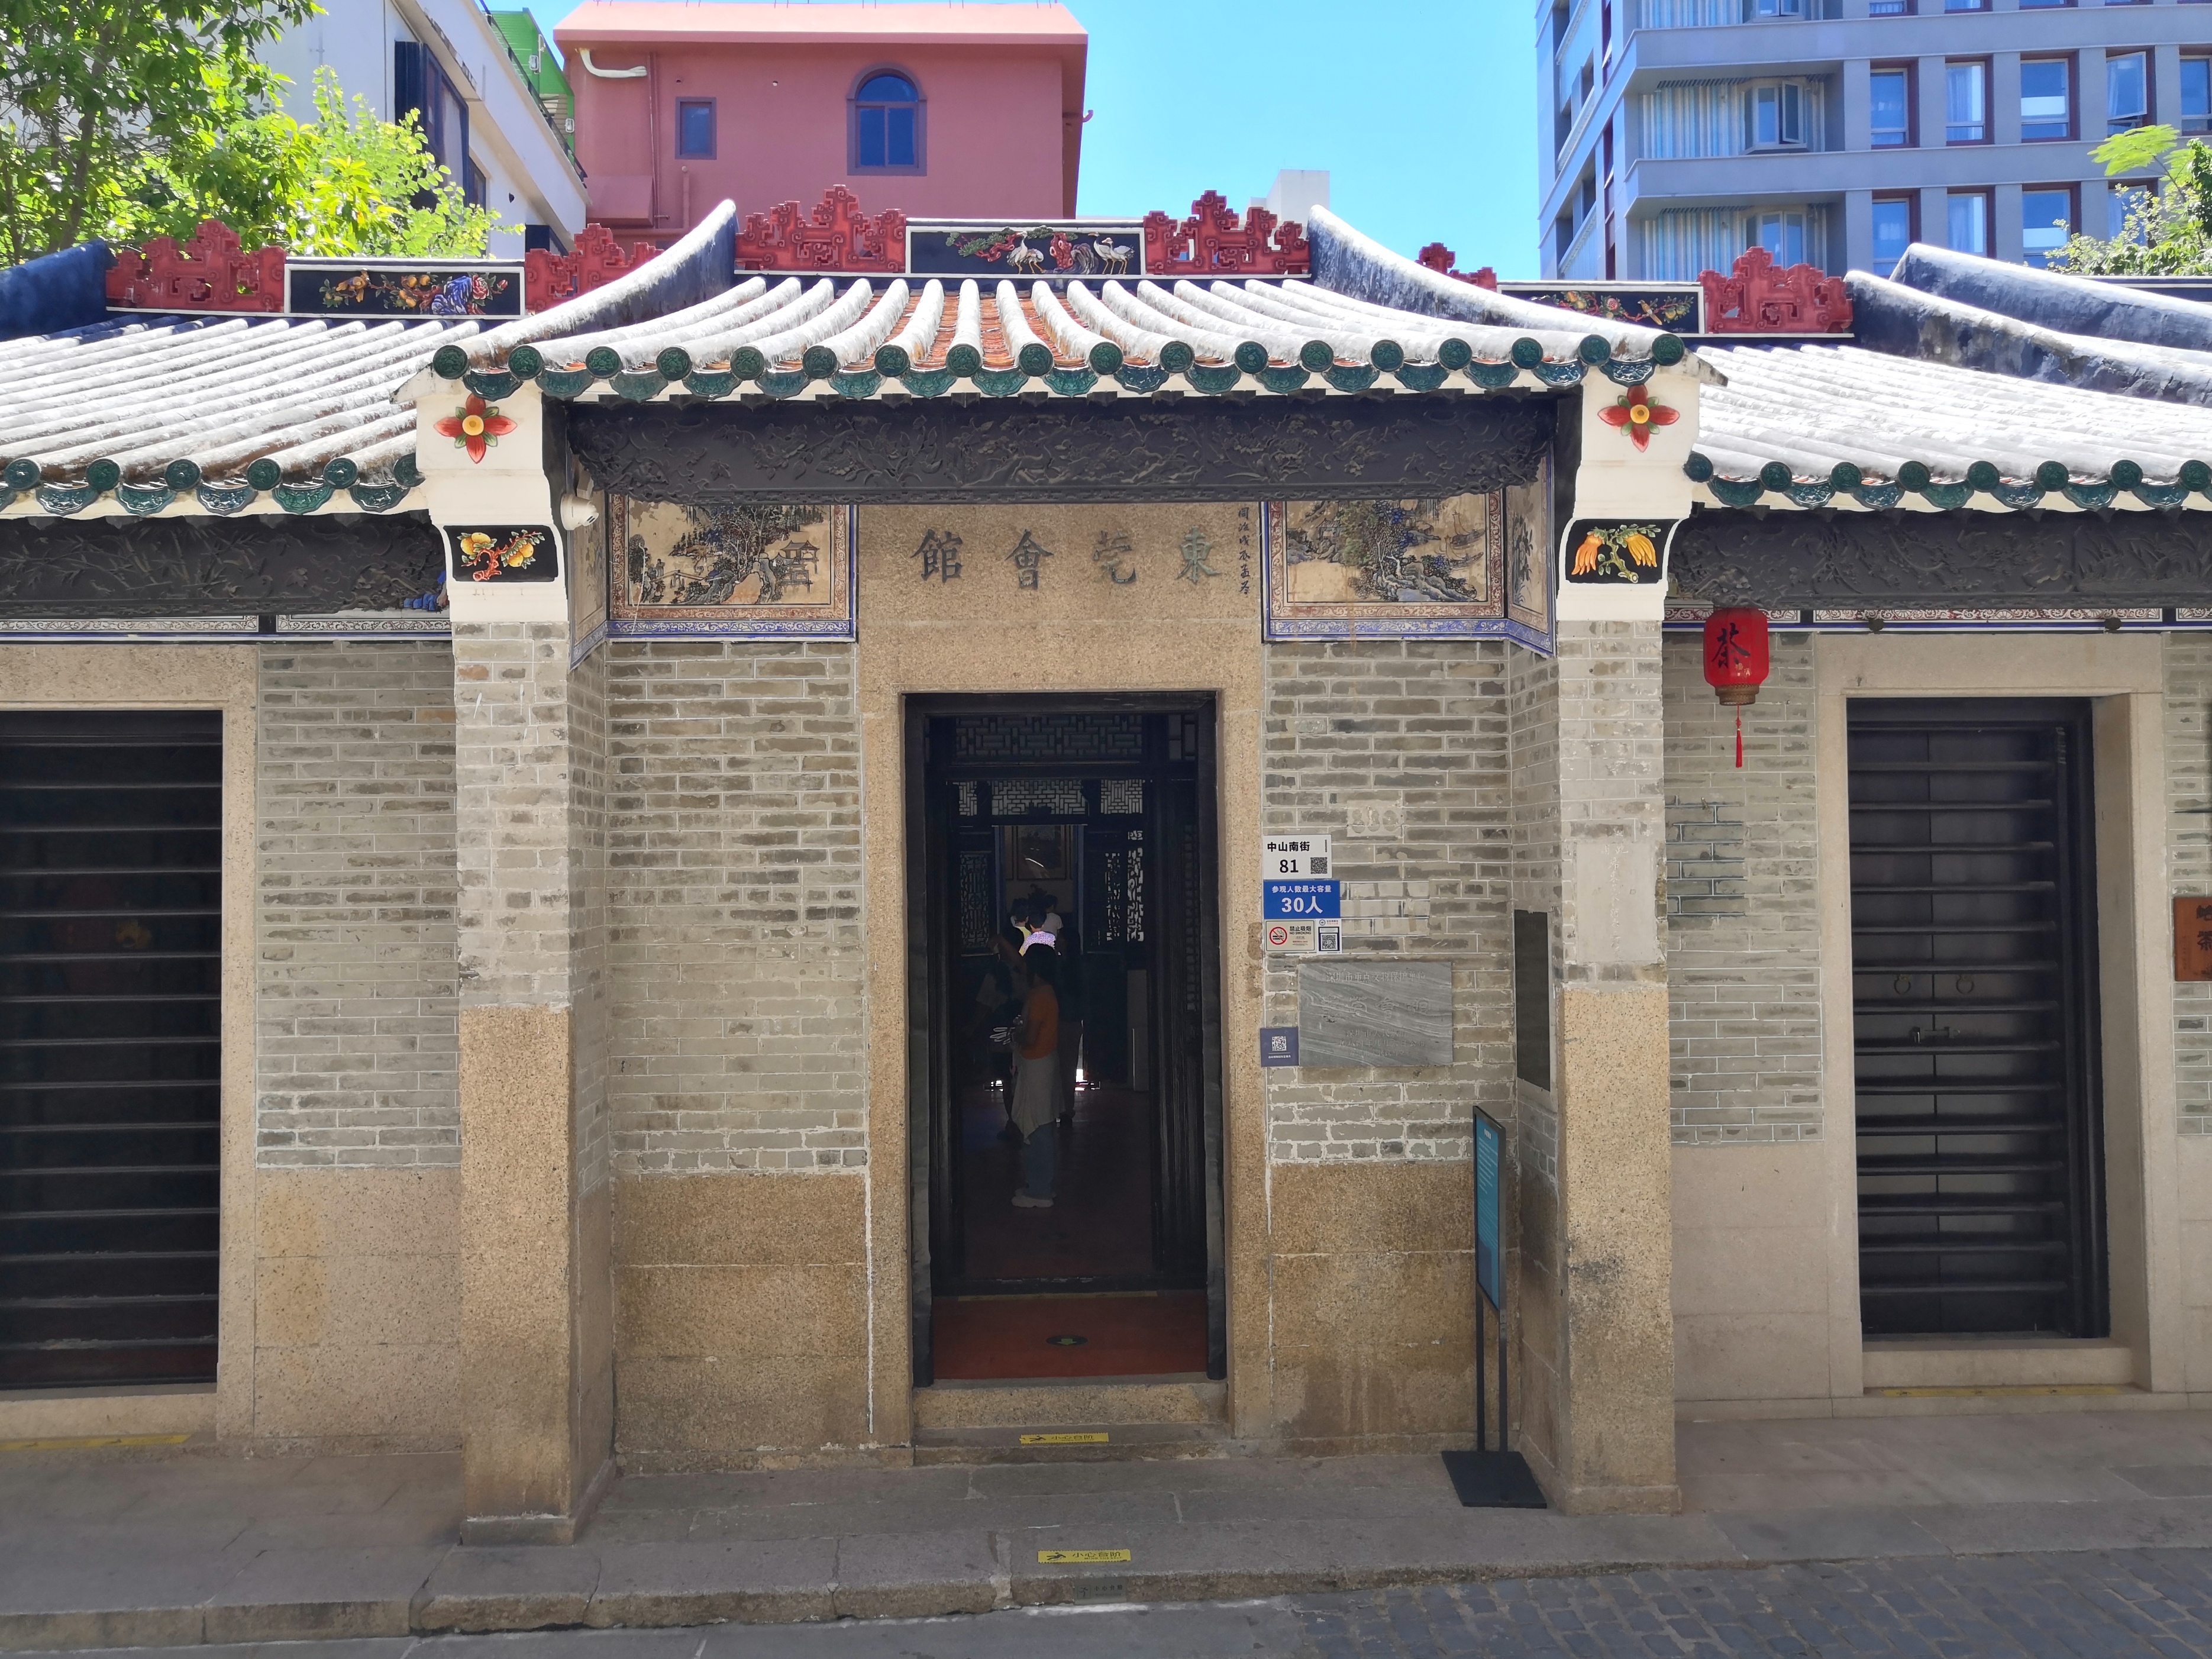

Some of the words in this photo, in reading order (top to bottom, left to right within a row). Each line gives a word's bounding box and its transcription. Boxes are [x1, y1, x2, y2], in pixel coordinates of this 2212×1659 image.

[909, 525, 1222, 590] 東莞會館
[1712, 622, 1751, 669] 茶
[1267, 841, 1310, 852] 中山南街
[1280, 859, 1299, 873] 81
[1271, 885, 1332, 893] 参观人数最大容量
[1281, 896, 1323, 914] 30人
[1326, 971, 1426, 983] 深圳市重点文物保护单位
